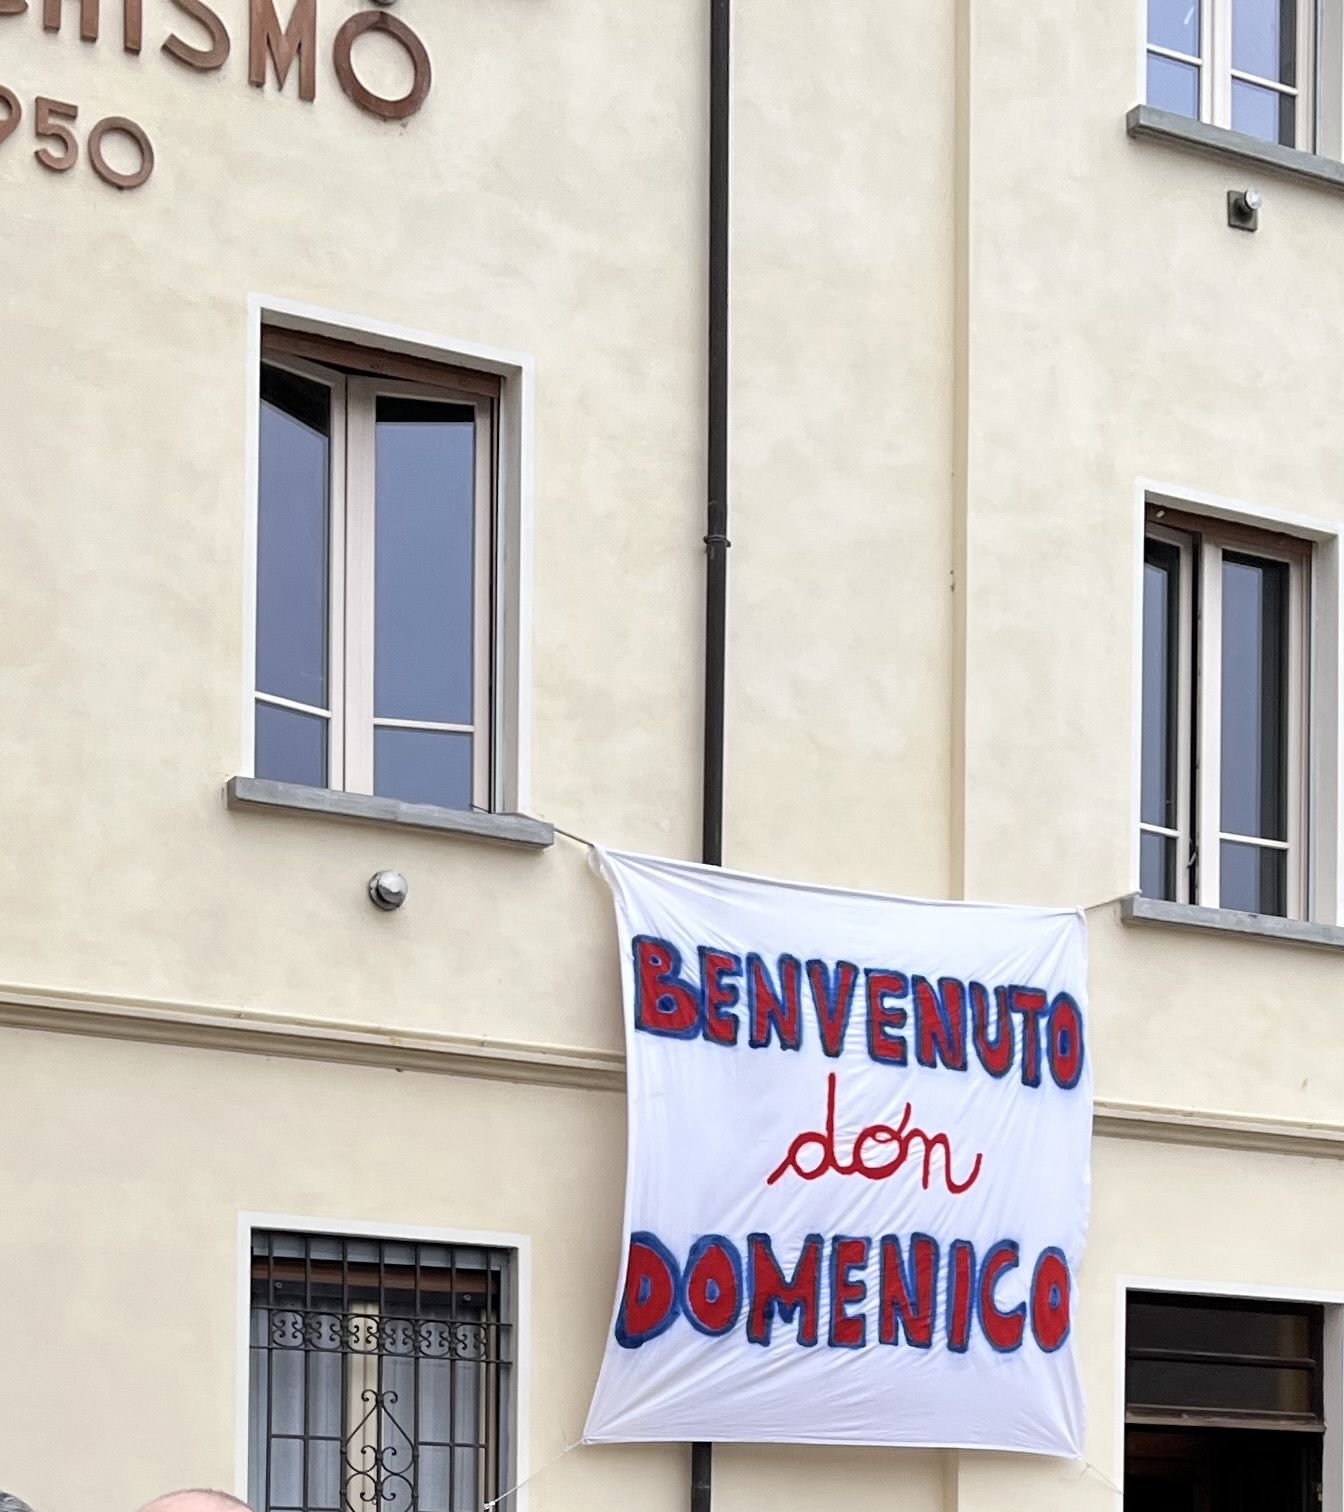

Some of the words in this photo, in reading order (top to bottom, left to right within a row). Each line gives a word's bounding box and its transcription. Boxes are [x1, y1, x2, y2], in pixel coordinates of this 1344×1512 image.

[630, 934, 1086, 1090] BENVENUTO
[766, 1072, 983, 1195] don
[614, 1230, 1072, 1354] DOMENICO
